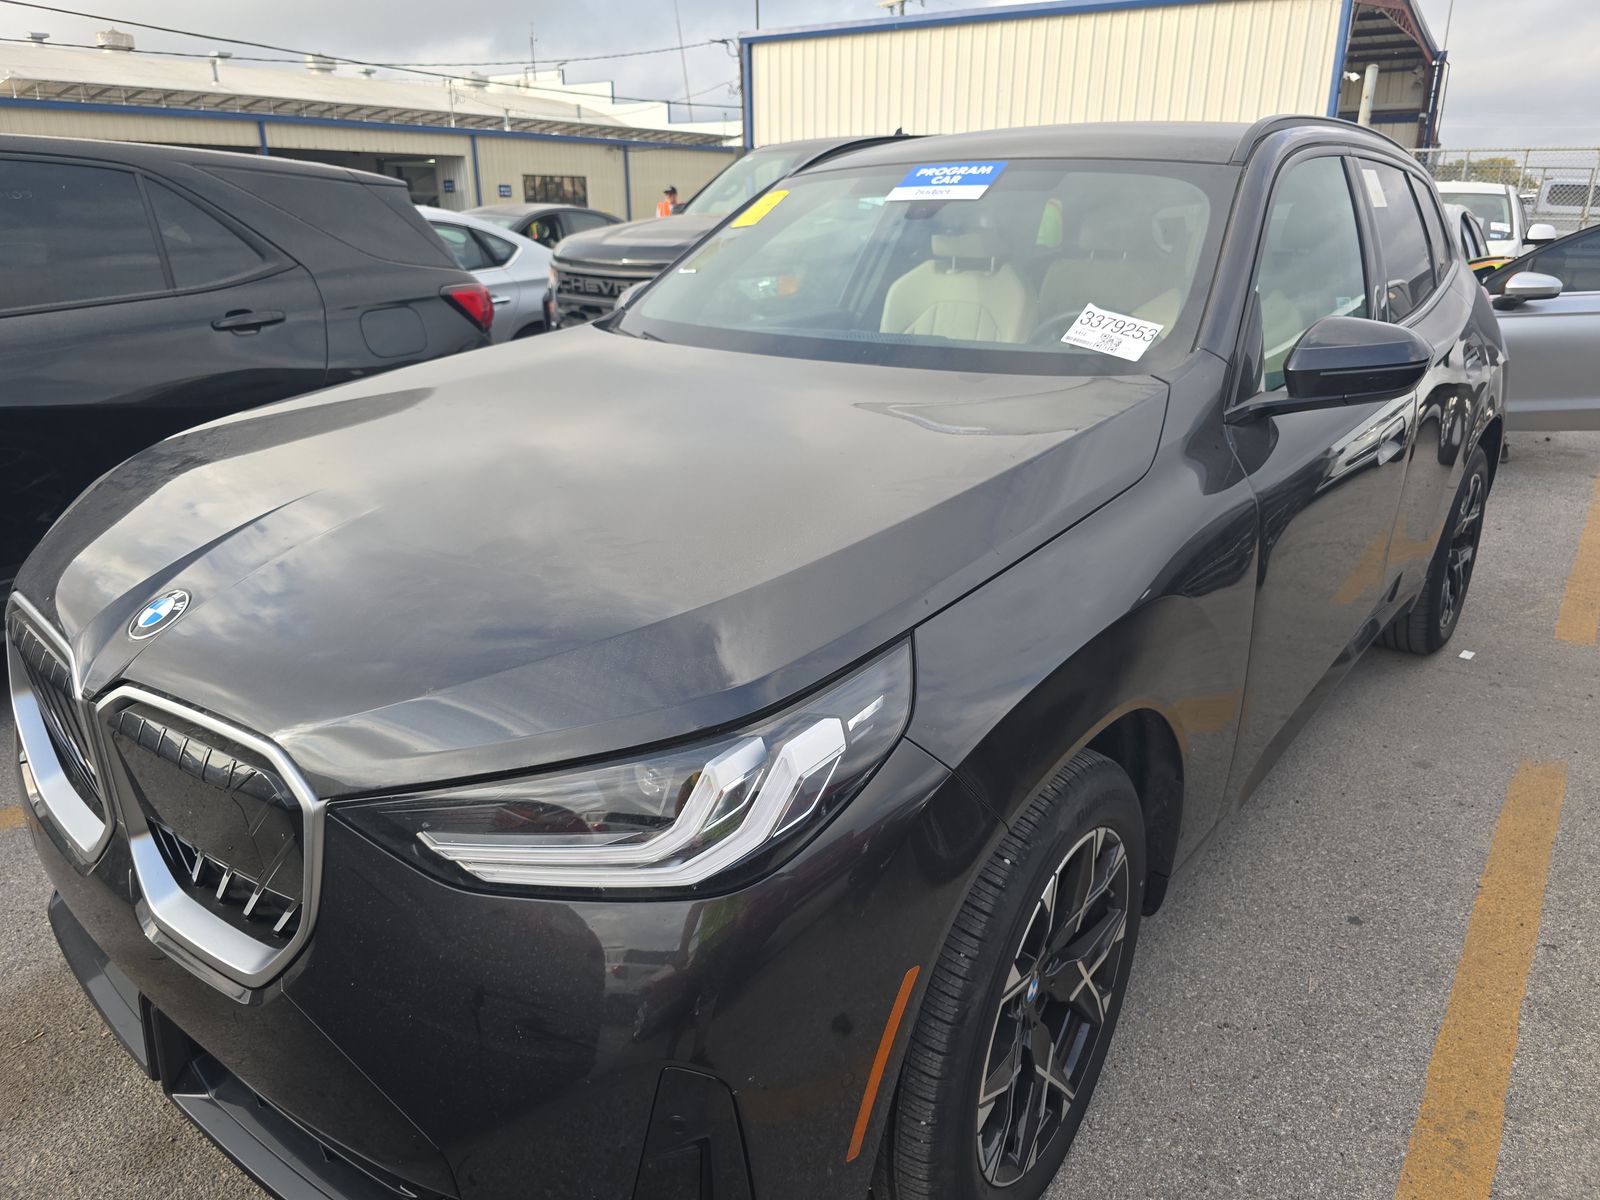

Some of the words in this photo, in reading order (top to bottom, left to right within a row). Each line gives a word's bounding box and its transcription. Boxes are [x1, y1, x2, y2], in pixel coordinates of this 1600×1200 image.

[915, 165, 994, 177] PROGRAM
[930, 175, 963, 185] CAR
[556, 277, 631, 296] CHEVR
[1080, 310, 1158, 342] 3379253
